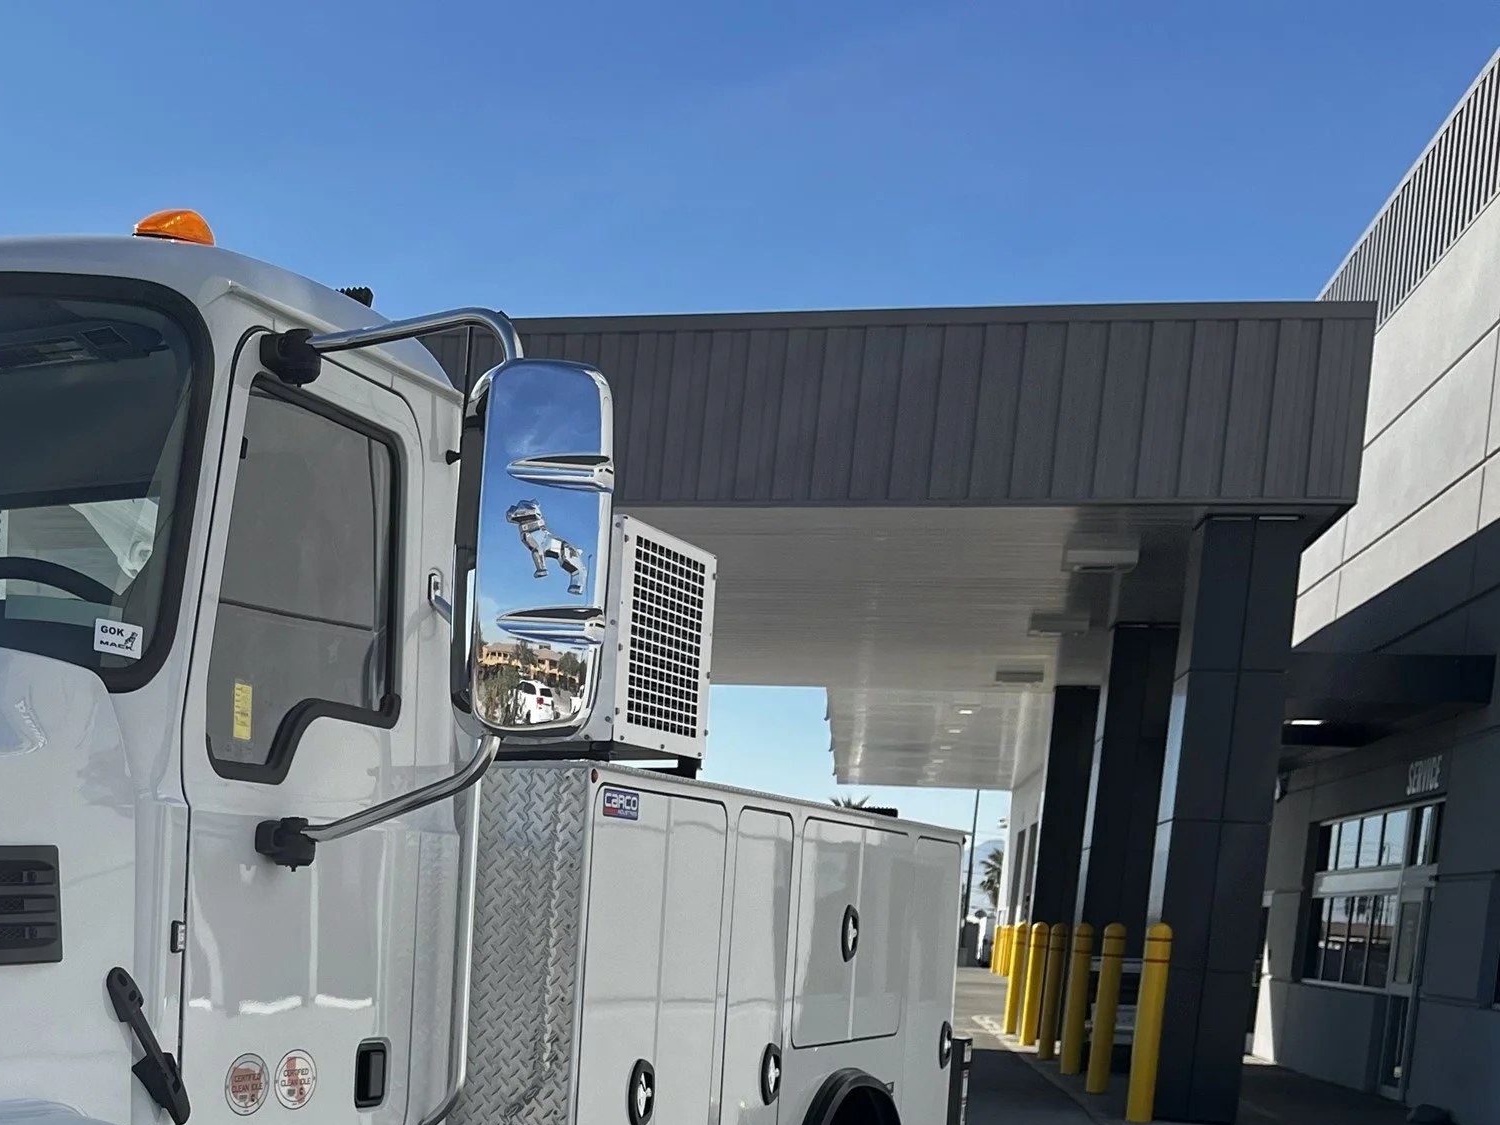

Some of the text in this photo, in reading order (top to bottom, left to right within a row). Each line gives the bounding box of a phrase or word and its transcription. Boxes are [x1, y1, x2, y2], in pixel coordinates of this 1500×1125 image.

[101, 625, 125, 637] GOK
[100, 640, 132, 651] MACK
[1406, 755, 1442, 795] SERVICE
[234, 1073, 261, 1082] CERTIFIED
[283, 1068, 309, 1077] CERTIFIED
[231, 1082, 263, 1093] CLEAN IDLE
[280, 1079, 298, 1087] CLEAN
